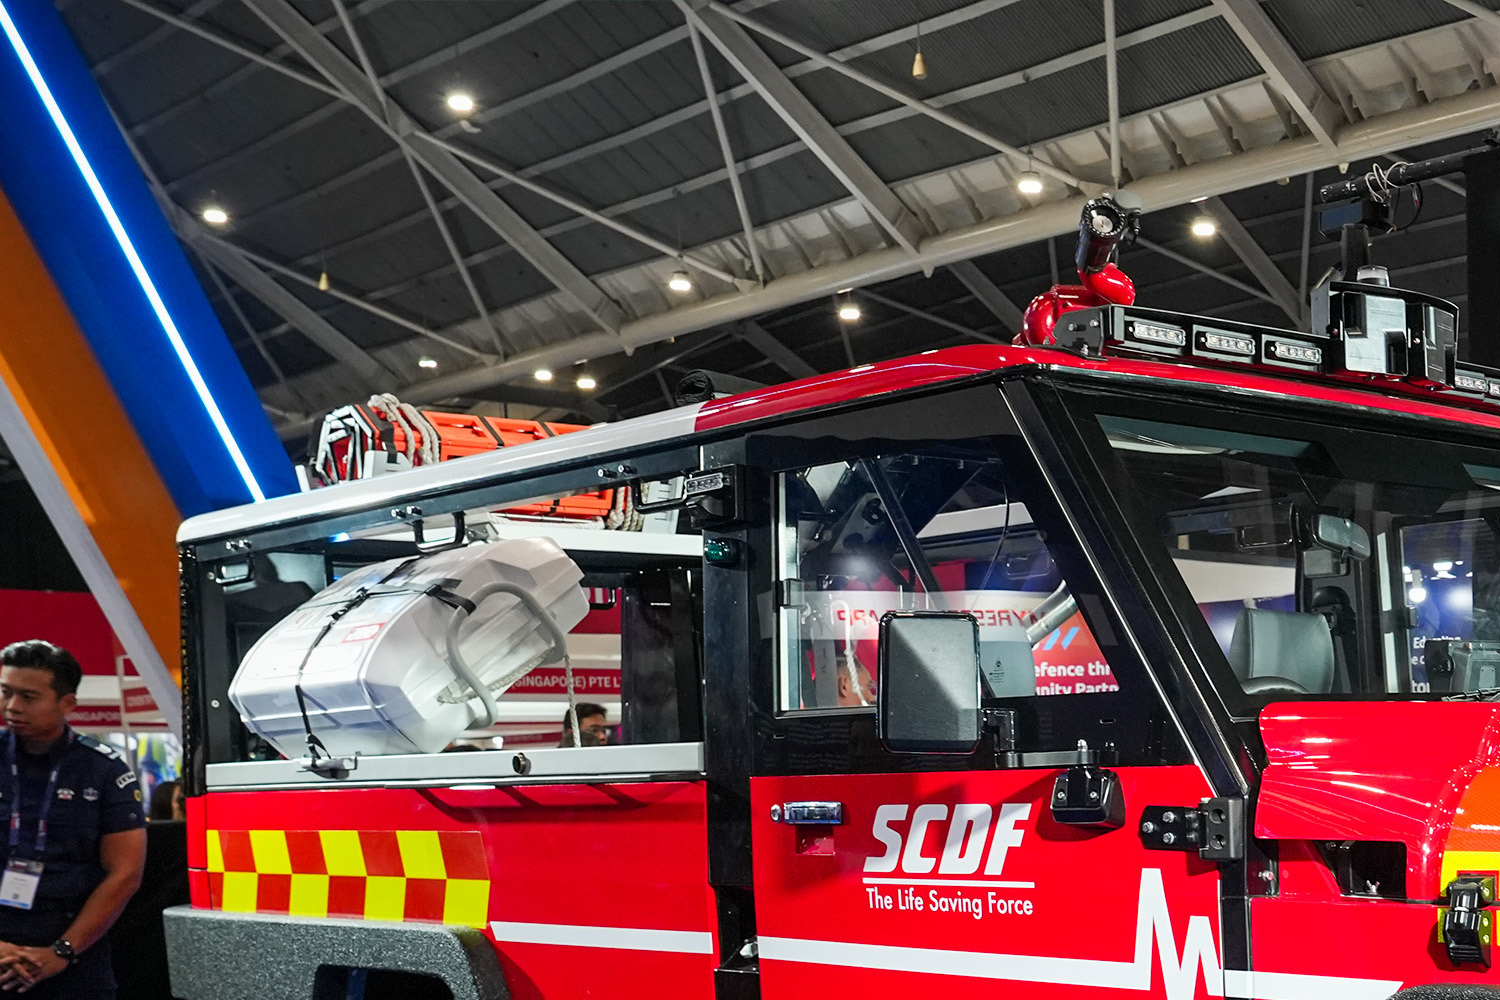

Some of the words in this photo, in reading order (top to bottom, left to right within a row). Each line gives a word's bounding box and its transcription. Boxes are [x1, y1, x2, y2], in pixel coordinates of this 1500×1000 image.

[588, 675, 612, 688] PTE
[862, 803, 1032, 875] SCDF
[866, 886, 893, 909] The
[898, 887, 924, 911] Life
[929, 889, 983, 920] Saving
[987, 891, 1033, 915] Force
